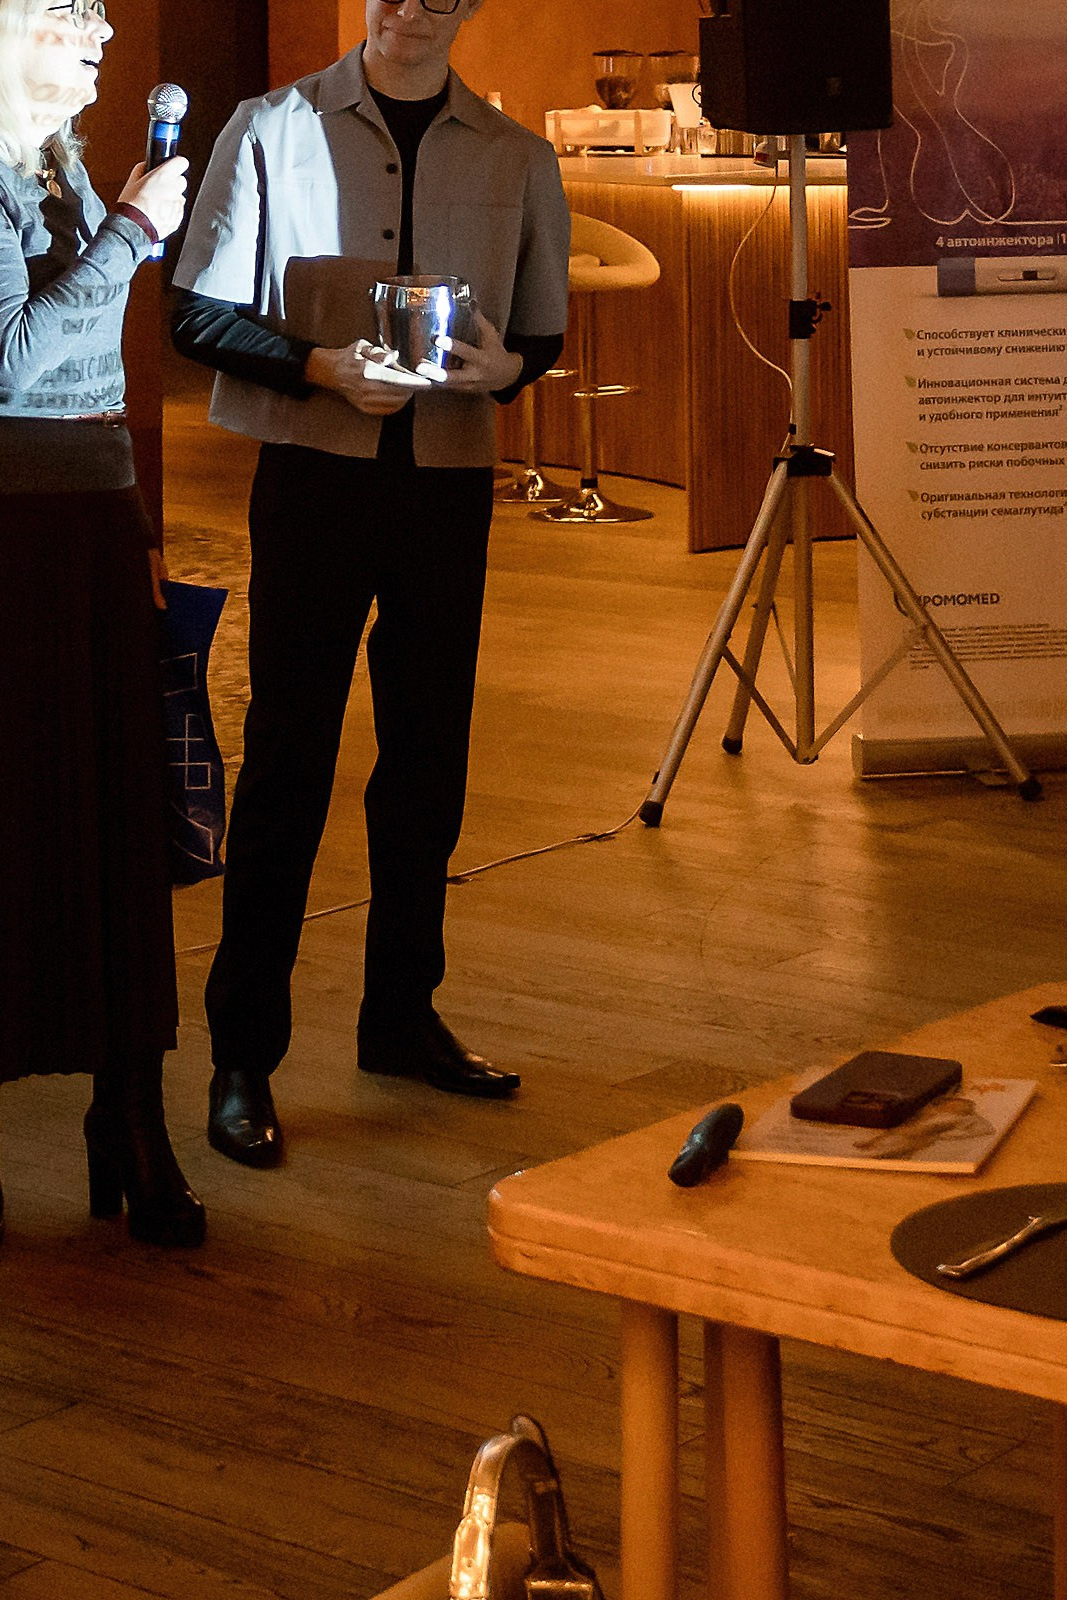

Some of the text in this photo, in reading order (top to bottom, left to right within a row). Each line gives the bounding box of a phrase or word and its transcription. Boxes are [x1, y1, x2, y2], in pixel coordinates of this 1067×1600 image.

[935, 236, 945, 248] 4
[947, 234, 1053, 248] автоинжектора
[917, 327, 1066, 341] Способствует клинически
[917, 343, 1066, 358] и устойчивому снижению
[918, 377, 1012, 390] Инновационная
[1014, 376, 1061, 386] система
[918, 393, 1001, 405] автоинжектор
[1004, 394, 1025, 404] для
[919, 413, 926, 422] и
[928, 409, 983, 423] удобного
[919, 442, 984, 456] Отсутствие
[919, 456, 1065, 471] снизить риски побочных
[920, 490, 1006, 505] Оригинальная
[921, 506, 988, 521] субстанции
